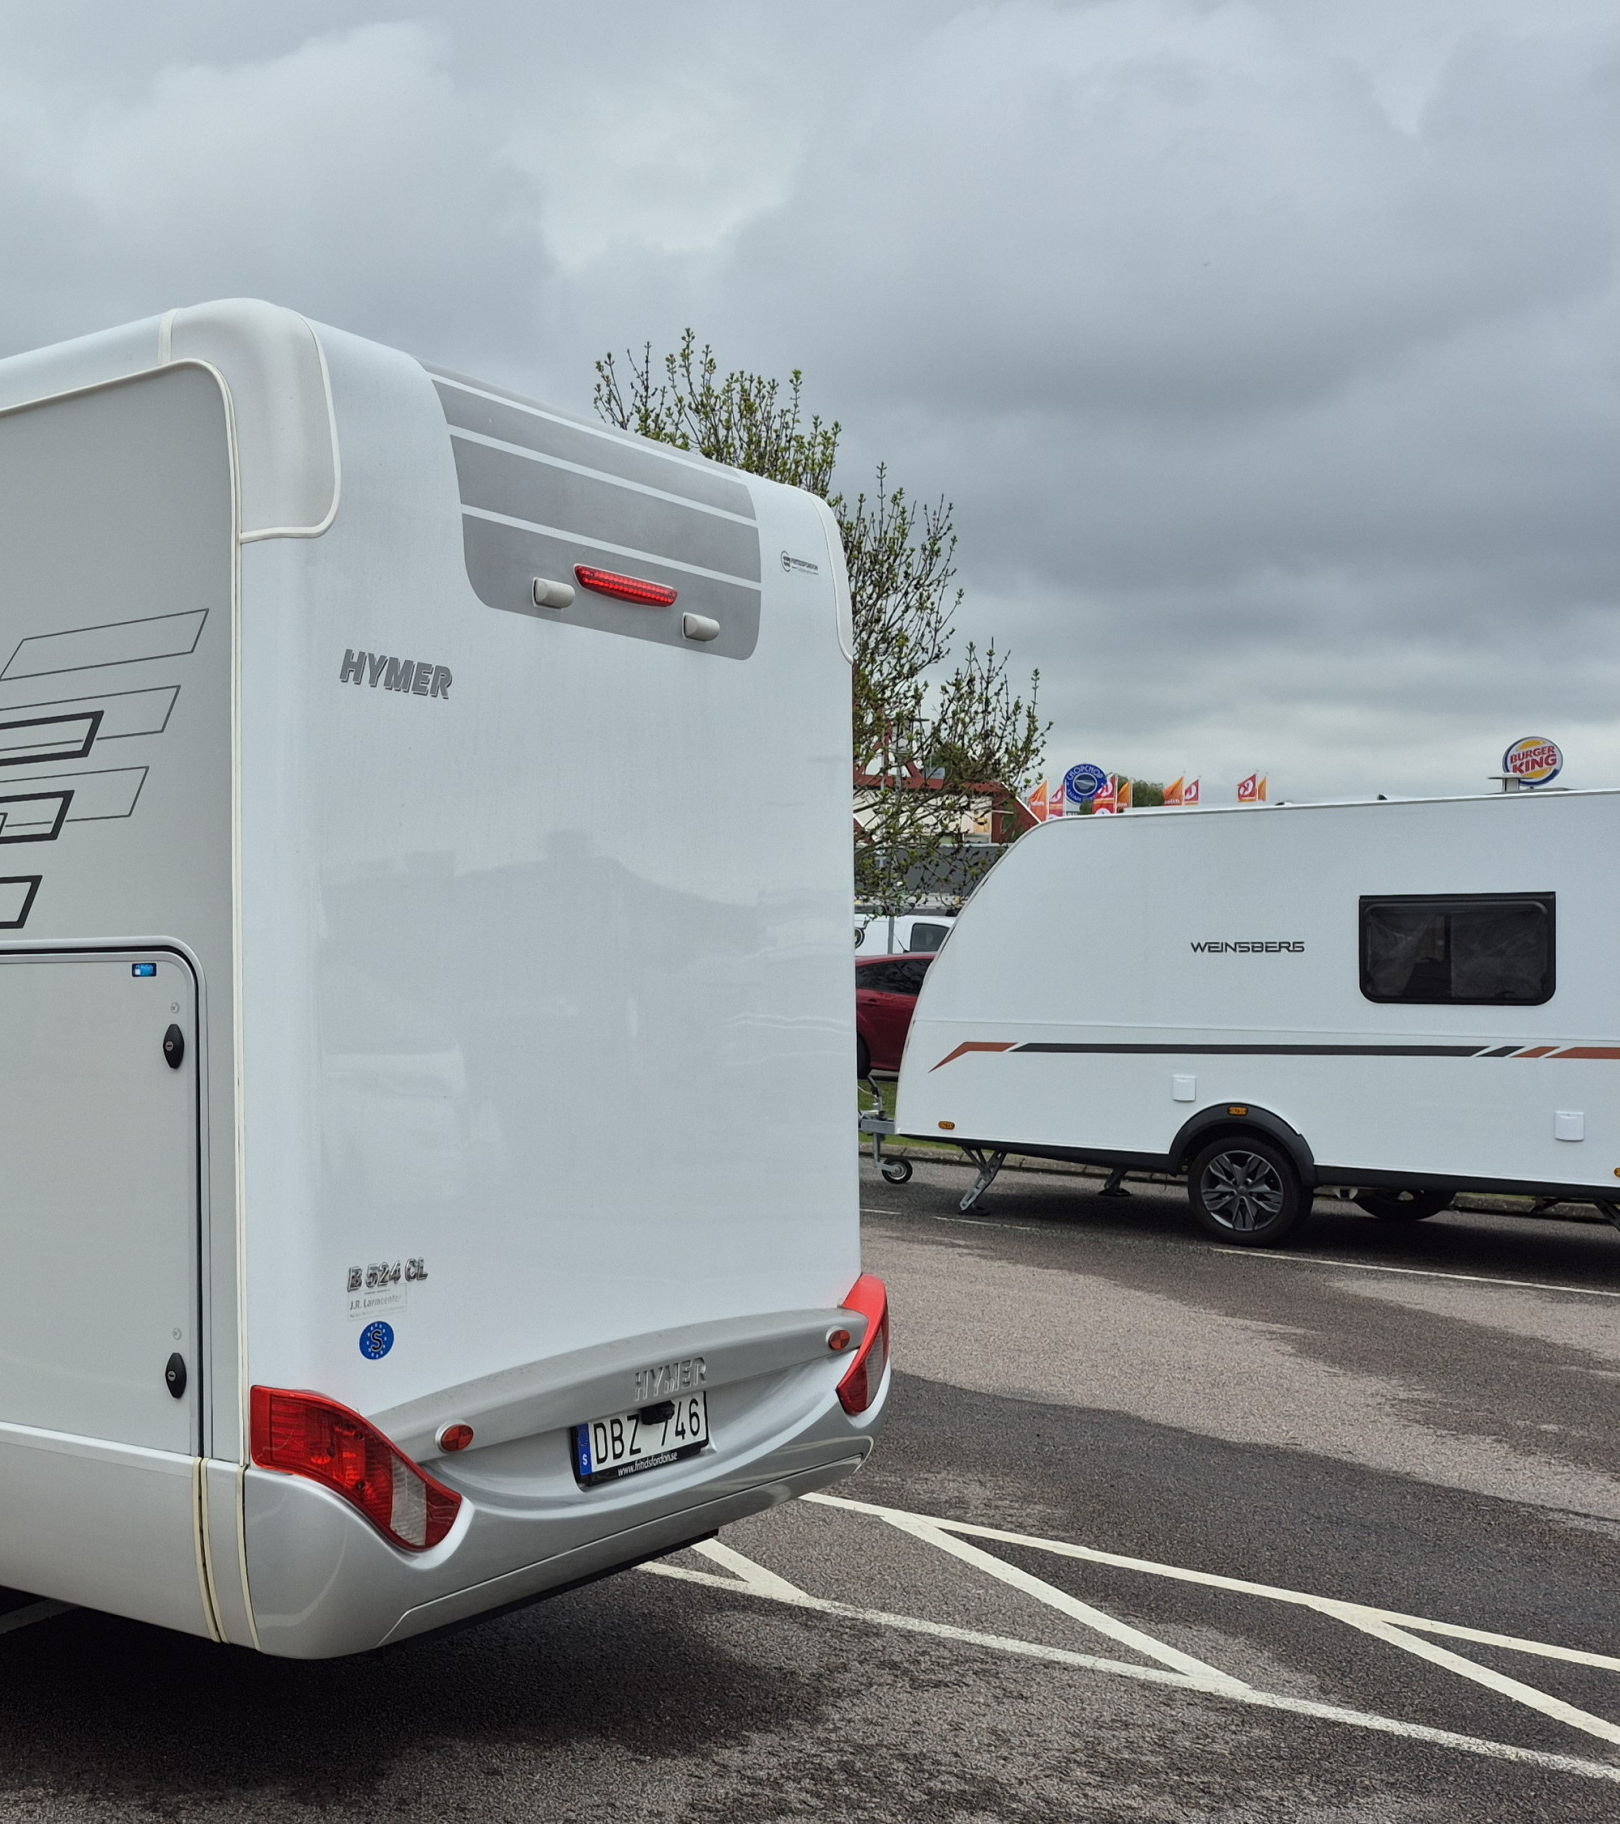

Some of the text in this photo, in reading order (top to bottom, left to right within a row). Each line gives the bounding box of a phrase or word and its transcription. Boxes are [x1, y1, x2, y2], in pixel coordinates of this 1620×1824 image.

[340, 649, 452, 699] HYMER
[1510, 745, 1555, 764] BURGER
[1512, 753, 1557, 774] KING
[1190, 941, 1305, 953] WEINSBERG
[347, 1256, 429, 1293] B 524 CL
[370, 1329, 384, 1352] S
[634, 1356, 707, 1402] HYMER
[593, 1413, 642, 1465] DBZ
[582, 1453, 588, 1466] S
